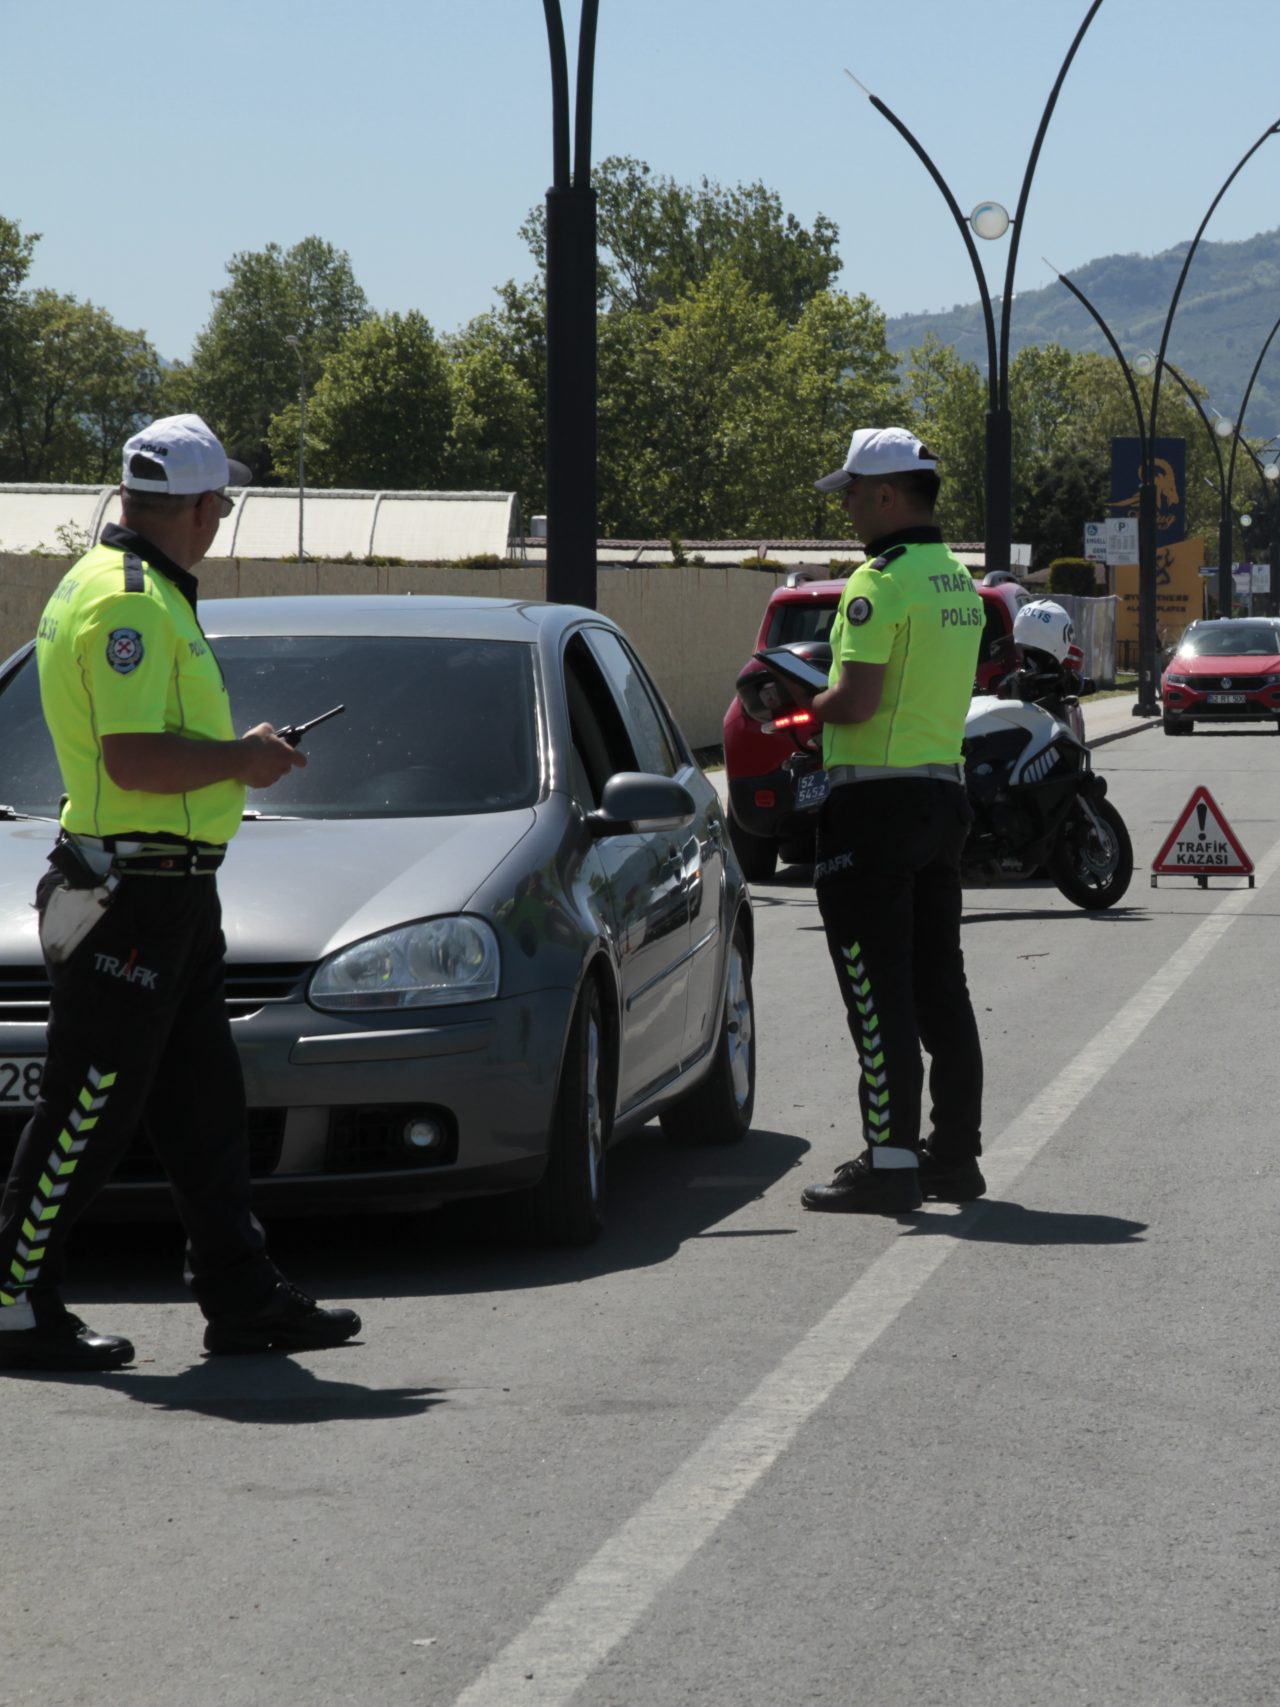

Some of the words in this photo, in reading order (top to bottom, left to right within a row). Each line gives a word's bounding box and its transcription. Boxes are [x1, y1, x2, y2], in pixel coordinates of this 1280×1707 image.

[801, 775, 815, 789] 52
[799, 785, 825, 802] 5452
[1176, 840, 1228, 853] TRAFİK
[1176, 854, 1228, 865] KAZASI
[0, 1062, 43, 1102] 28
